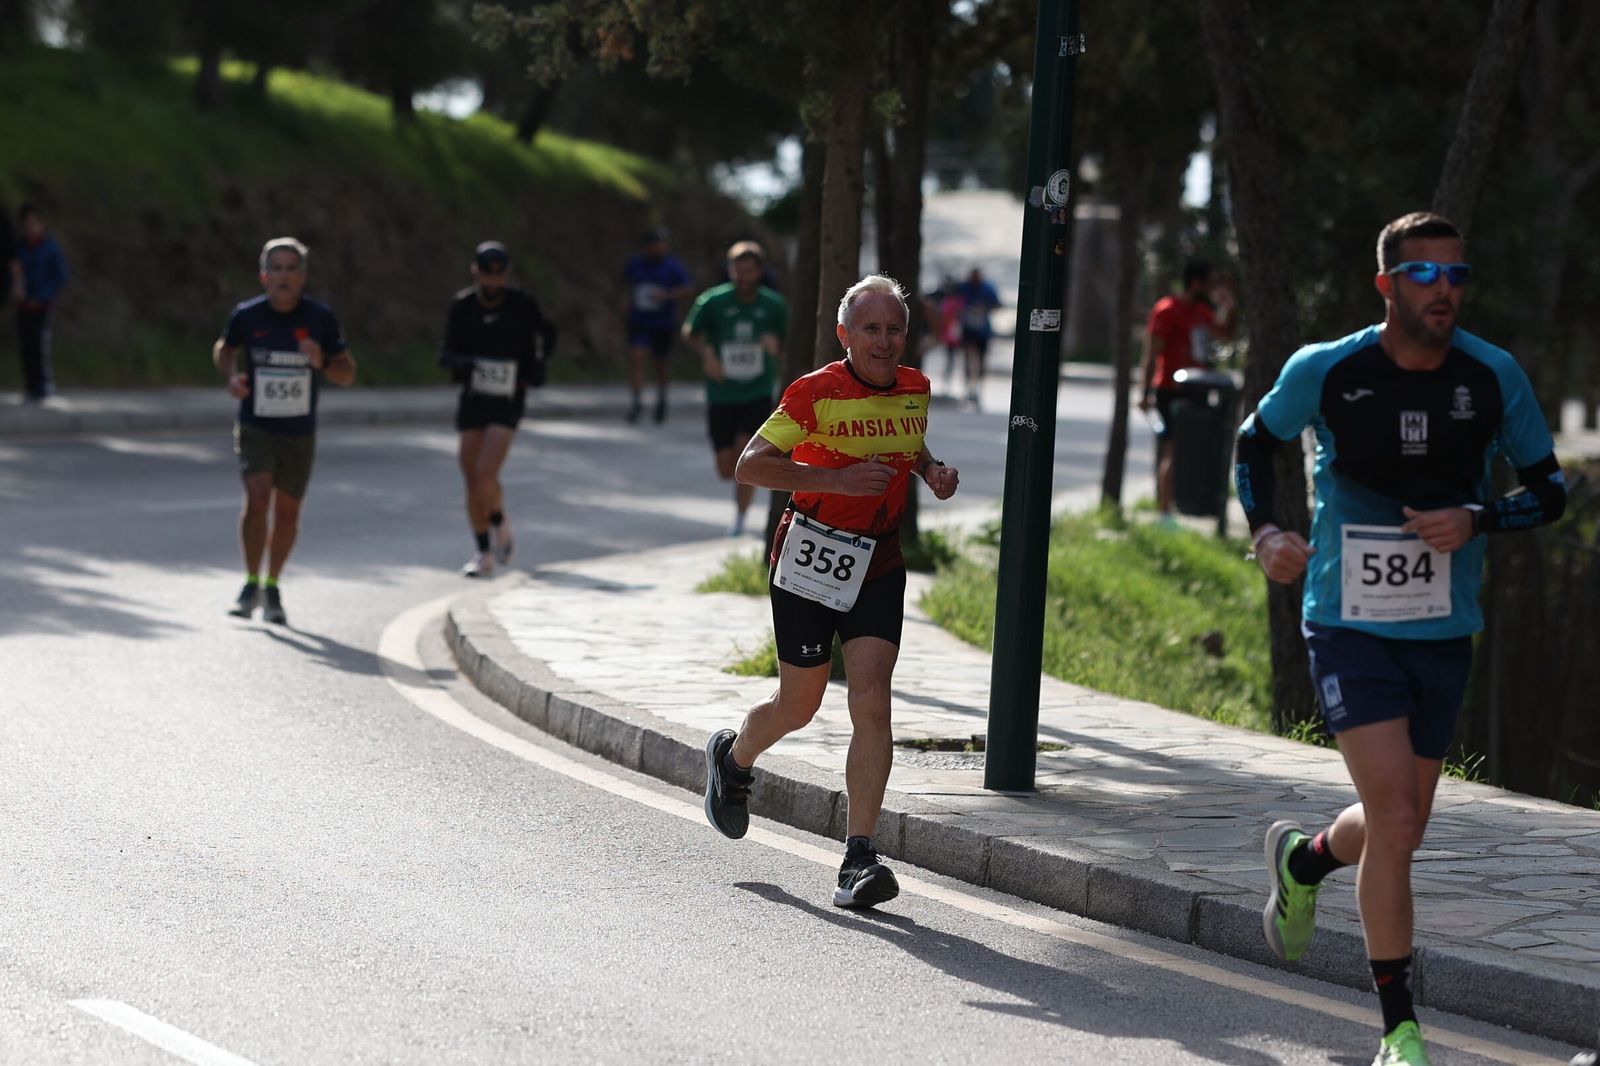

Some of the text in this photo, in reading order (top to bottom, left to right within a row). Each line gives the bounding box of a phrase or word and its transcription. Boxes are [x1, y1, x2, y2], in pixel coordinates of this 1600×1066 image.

[264, 380, 303, 400] 656
[794, 539, 856, 581] 358
[1362, 551, 1435, 587] 584
